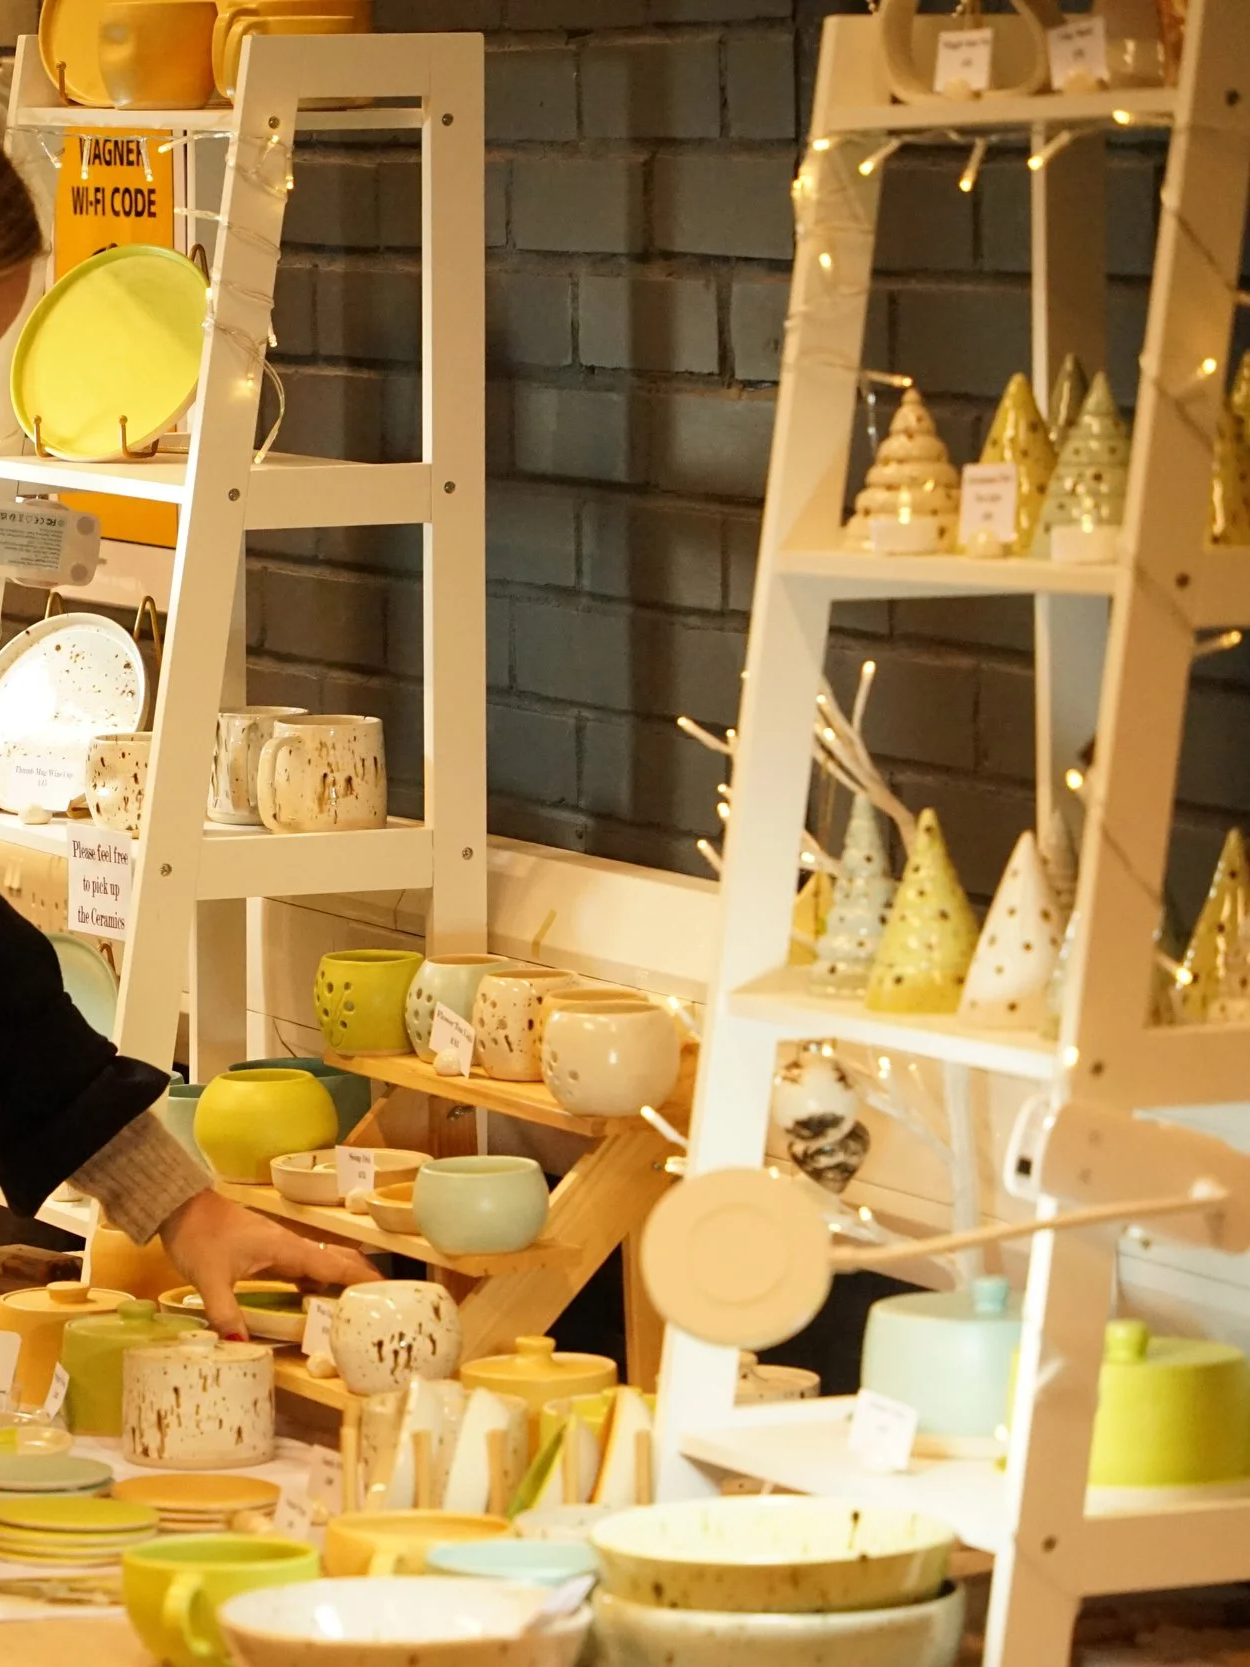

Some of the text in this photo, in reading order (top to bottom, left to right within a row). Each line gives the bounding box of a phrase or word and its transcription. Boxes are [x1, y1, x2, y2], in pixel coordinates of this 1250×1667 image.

[72, 186, 157, 218] WI-FI CODE
[72, 840, 129, 865] Please feel free
[83, 875, 120, 901] to pick up
[78, 905, 125, 930] the Ceramics
